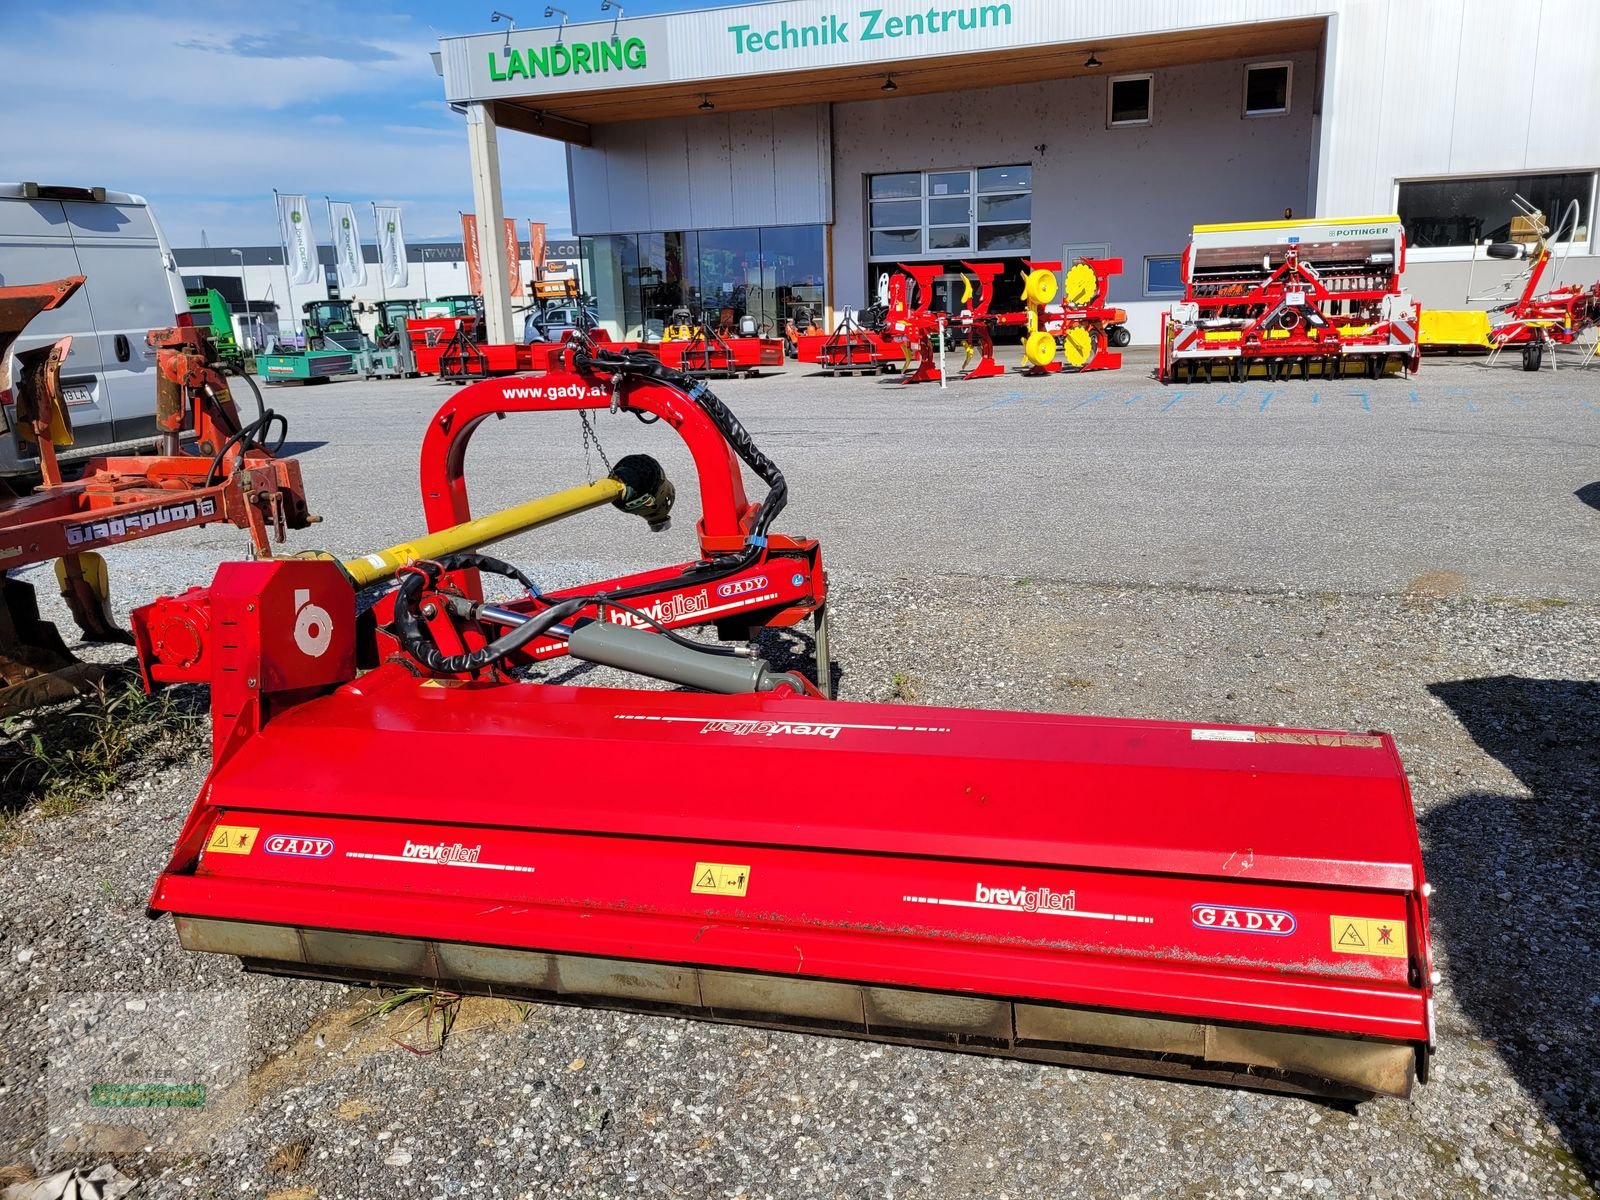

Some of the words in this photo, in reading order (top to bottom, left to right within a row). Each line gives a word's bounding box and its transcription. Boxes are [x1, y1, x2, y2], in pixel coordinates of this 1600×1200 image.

[727, 16, 848, 54] Technik
[858, 3, 1012, 42] Zentrum
[488, 37, 647, 81] LANDRING
[502, 384, 608, 400] www.gady.at
[721, 578, 765, 595] GADY
[700, 720, 841, 739] breviglieri
[270, 837, 329, 856] GADY
[402, 840, 481, 864] breviglieri
[975, 882, 1076, 912] breviglieri
[1198, 908, 1286, 932] GADY
